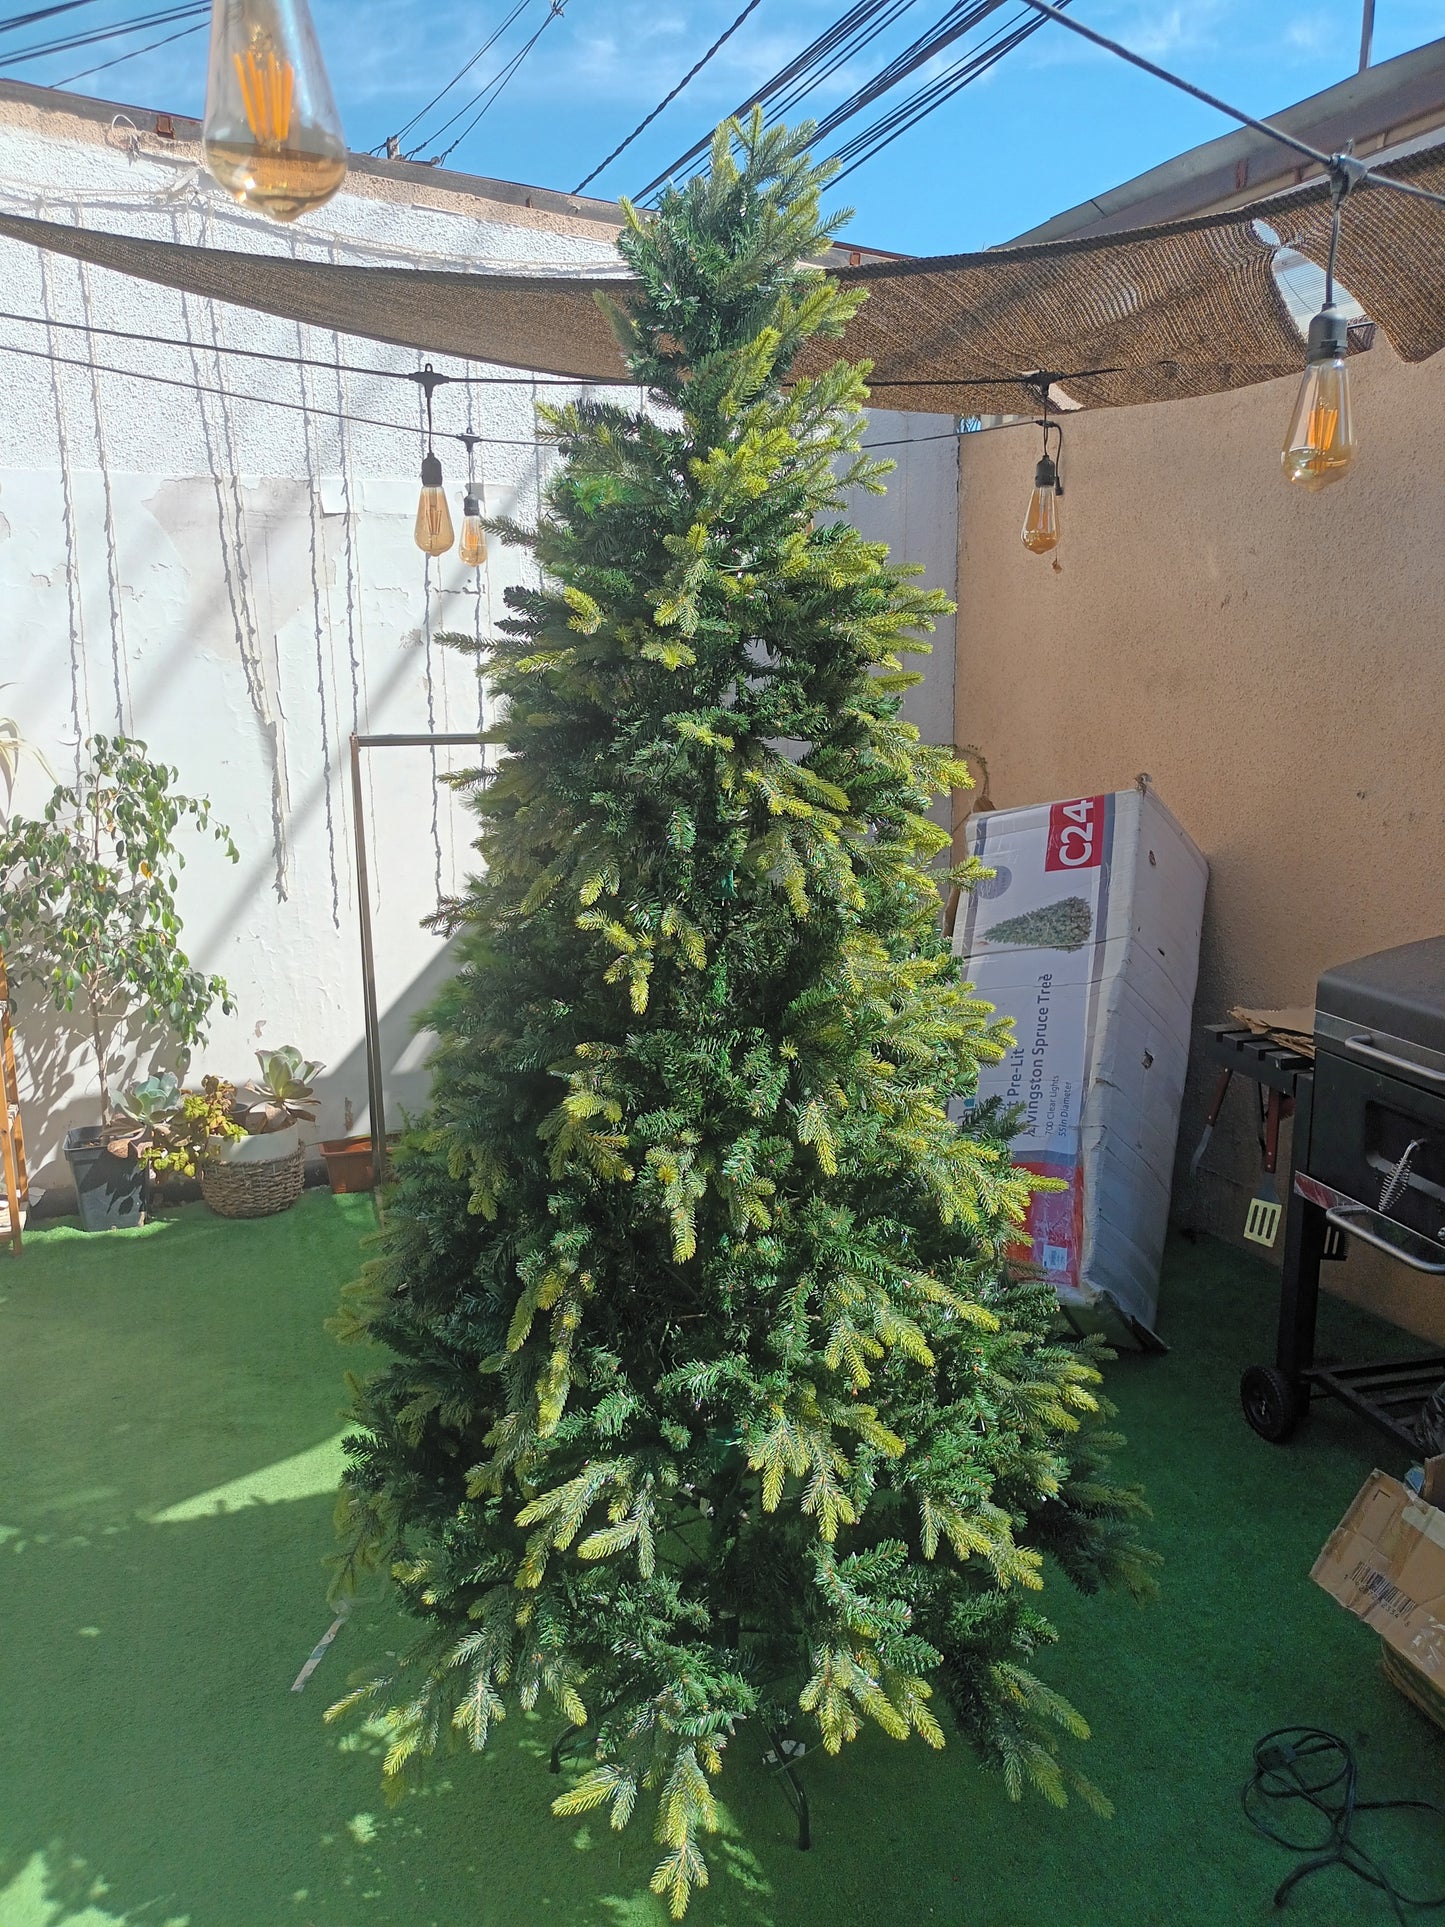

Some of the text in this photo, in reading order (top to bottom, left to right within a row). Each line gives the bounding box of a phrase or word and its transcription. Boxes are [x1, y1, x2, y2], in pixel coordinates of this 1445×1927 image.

[1059, 800, 1094, 867] C24
[1031, 1007, 1049, 1056] Spruce
[1007, 1048, 1025, 1097] Pre-Lit
[1023, 1060, 1044, 1135] Lvingston
[1060, 1081, 1072, 1118] Diameter
[1045, 1074, 1060, 1135] 700 Clear Lights
